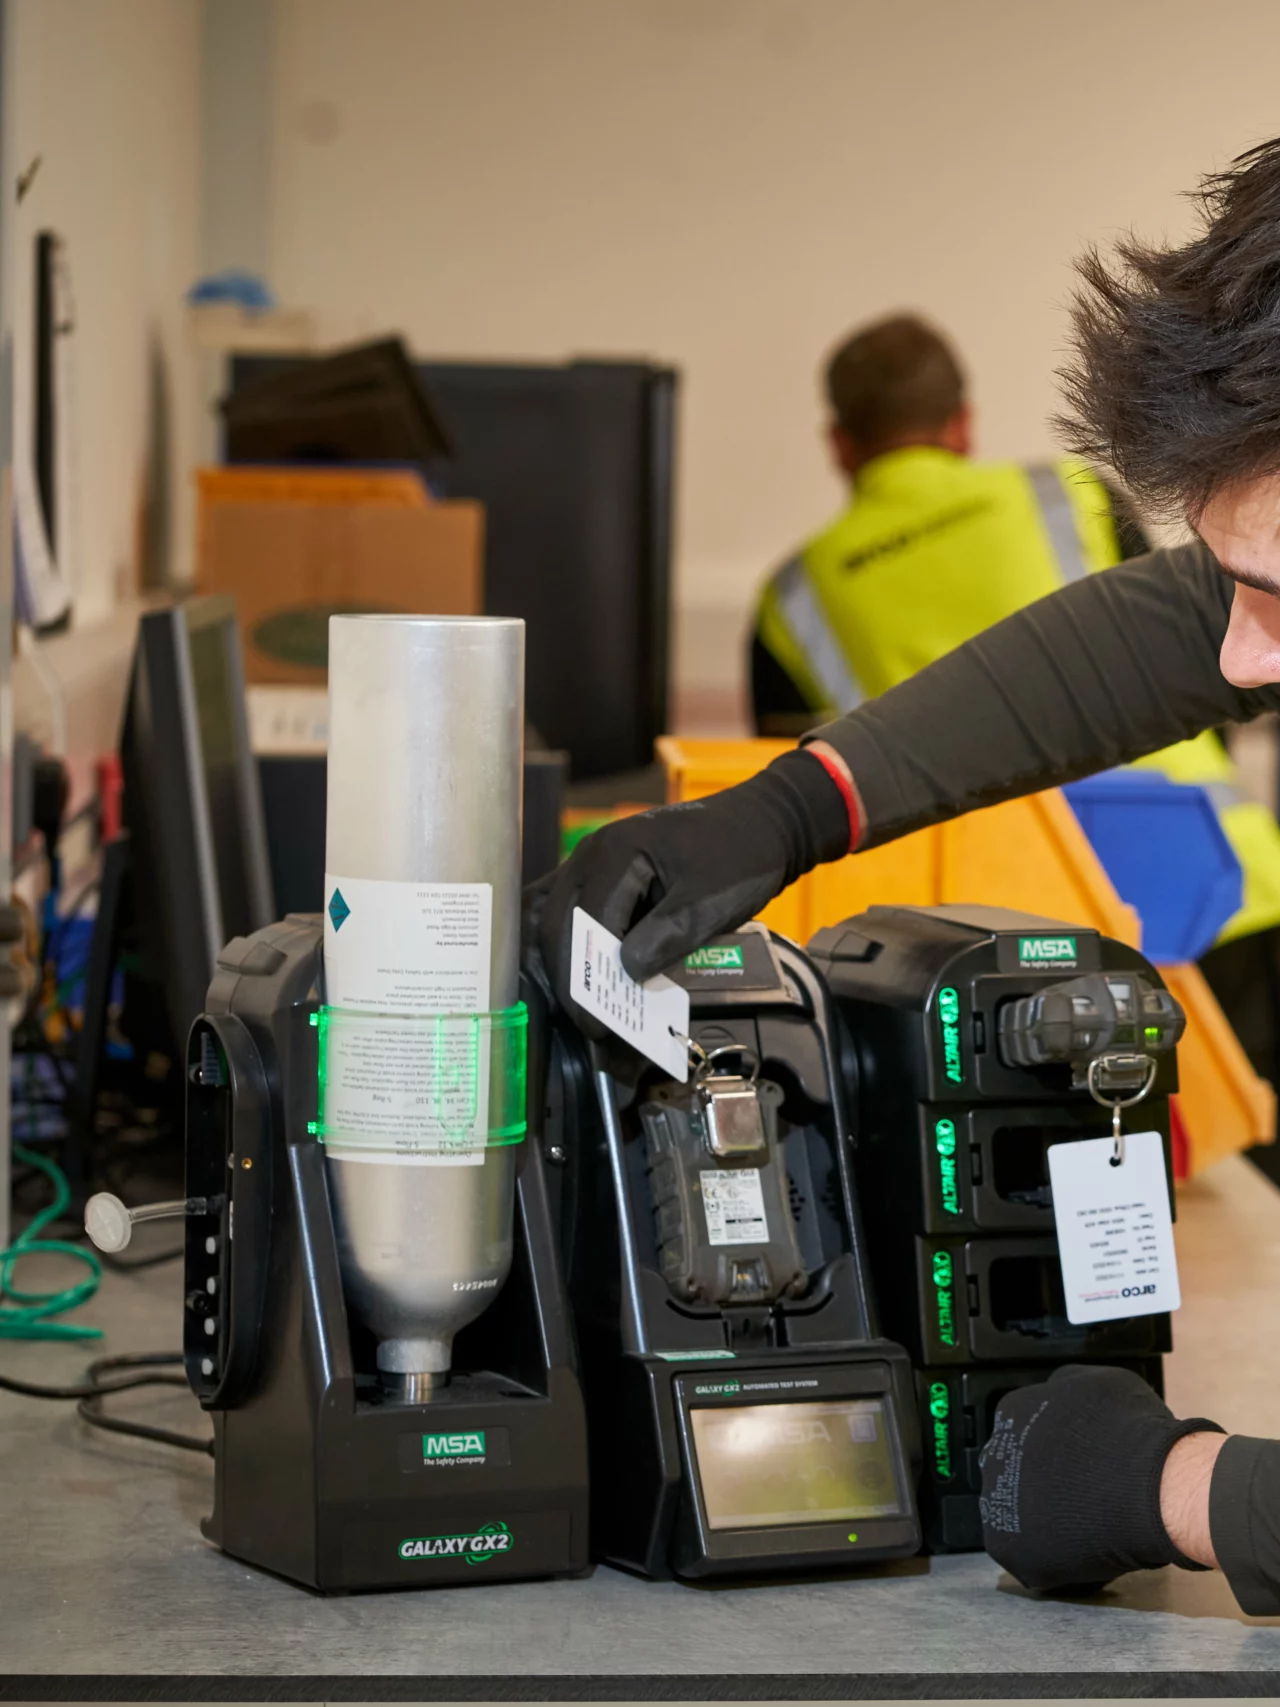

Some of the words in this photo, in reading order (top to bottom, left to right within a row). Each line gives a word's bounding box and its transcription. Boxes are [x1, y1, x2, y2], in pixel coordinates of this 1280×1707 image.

[687, 947, 742, 965] MSA
[1022, 939, 1075, 958] MSA
[583, 961, 591, 992] arco
[944, 1027, 961, 1083] ALTAIR
[940, 1159, 958, 1214] ALTAIR
[1122, 1284, 1156, 1298] arco
[937, 1291, 955, 1346] ALTAIR
[695, 1384, 723, 1394] GALAXY
[724, 1383, 740, 1393] GX2
[742, 1381, 779, 1391] AUTOMATED
[780, 1380, 794, 1389] TEST
[794, 1379, 819, 1388] SYSTEM
[427, 1434, 483, 1455] MSA
[934, 1423, 951, 1477] ALTAIR
[423, 1458, 435, 1466] The
[435, 1457, 455, 1467] Safety
[456, 1456, 486, 1465] Company
[400, 1537, 468, 1558] GALAXY
[470, 1533, 509, 1552] GX2
